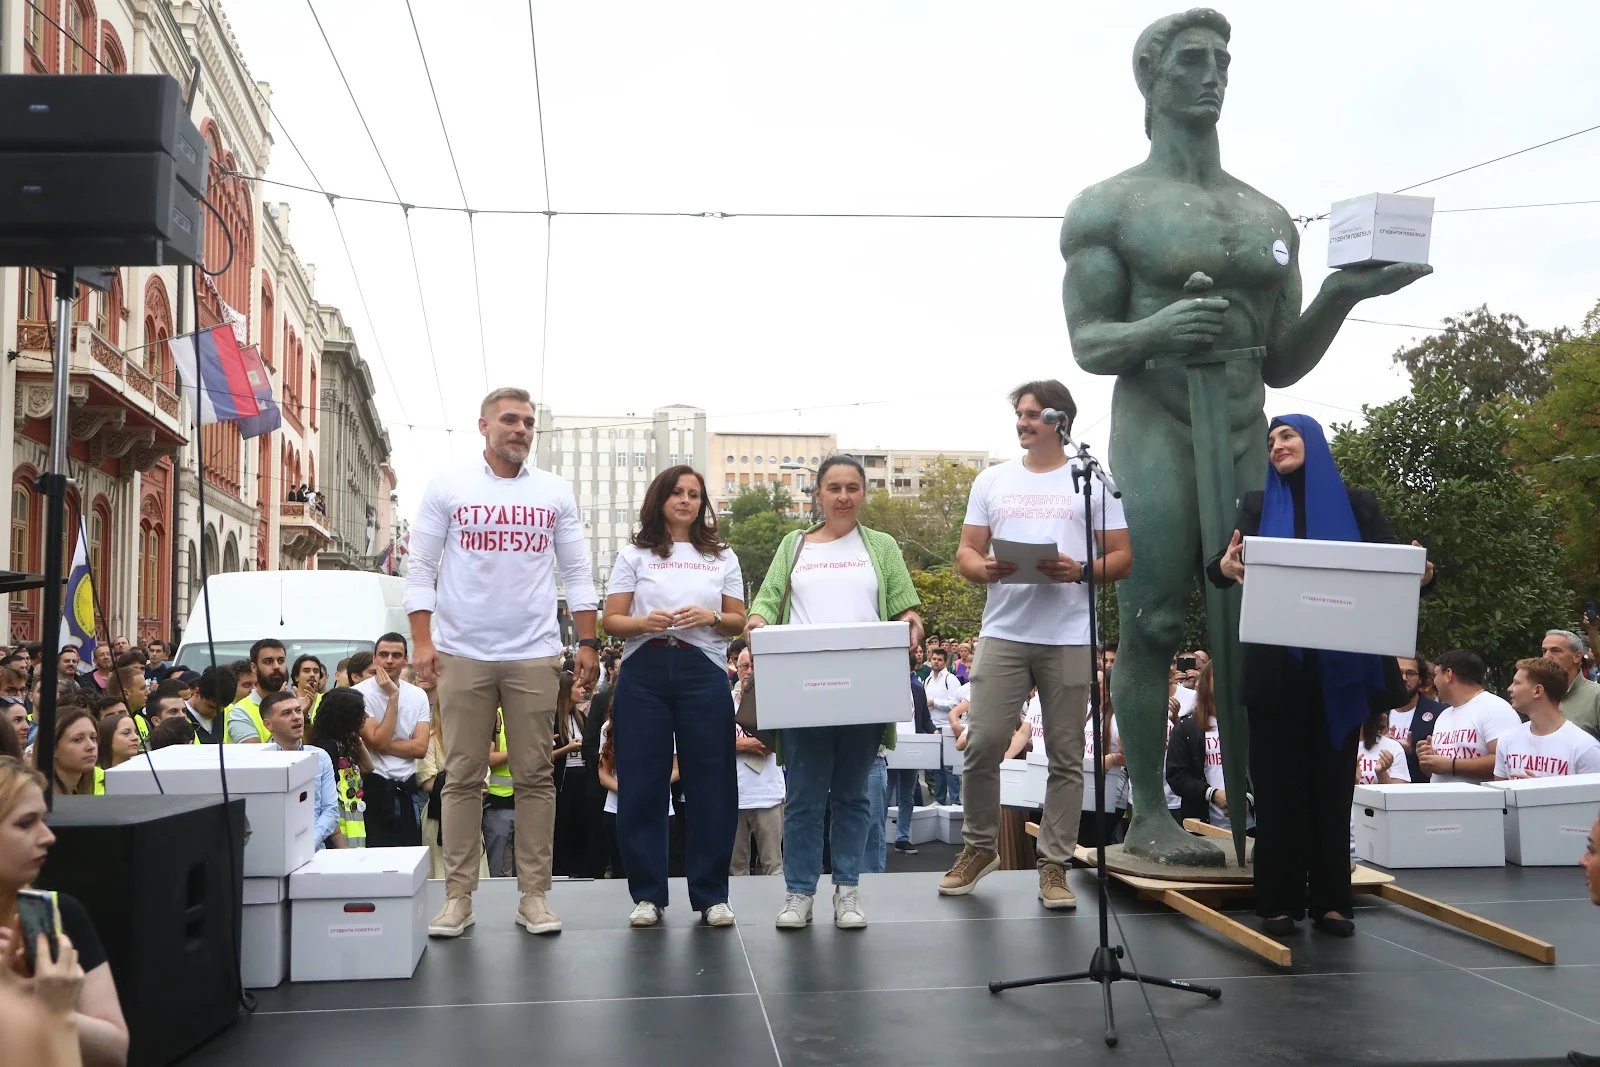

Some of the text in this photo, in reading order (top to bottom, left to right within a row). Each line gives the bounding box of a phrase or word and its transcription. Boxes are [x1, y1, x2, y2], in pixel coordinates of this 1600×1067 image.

[457, 505, 556, 529] СТУДЕНТИ
[648, 561, 683, 571] СТУДЕНТИ
[1433, 729, 1477, 745] ТУДЕНТИ
[1505, 753, 1569, 776] СТУДЕНТИ
